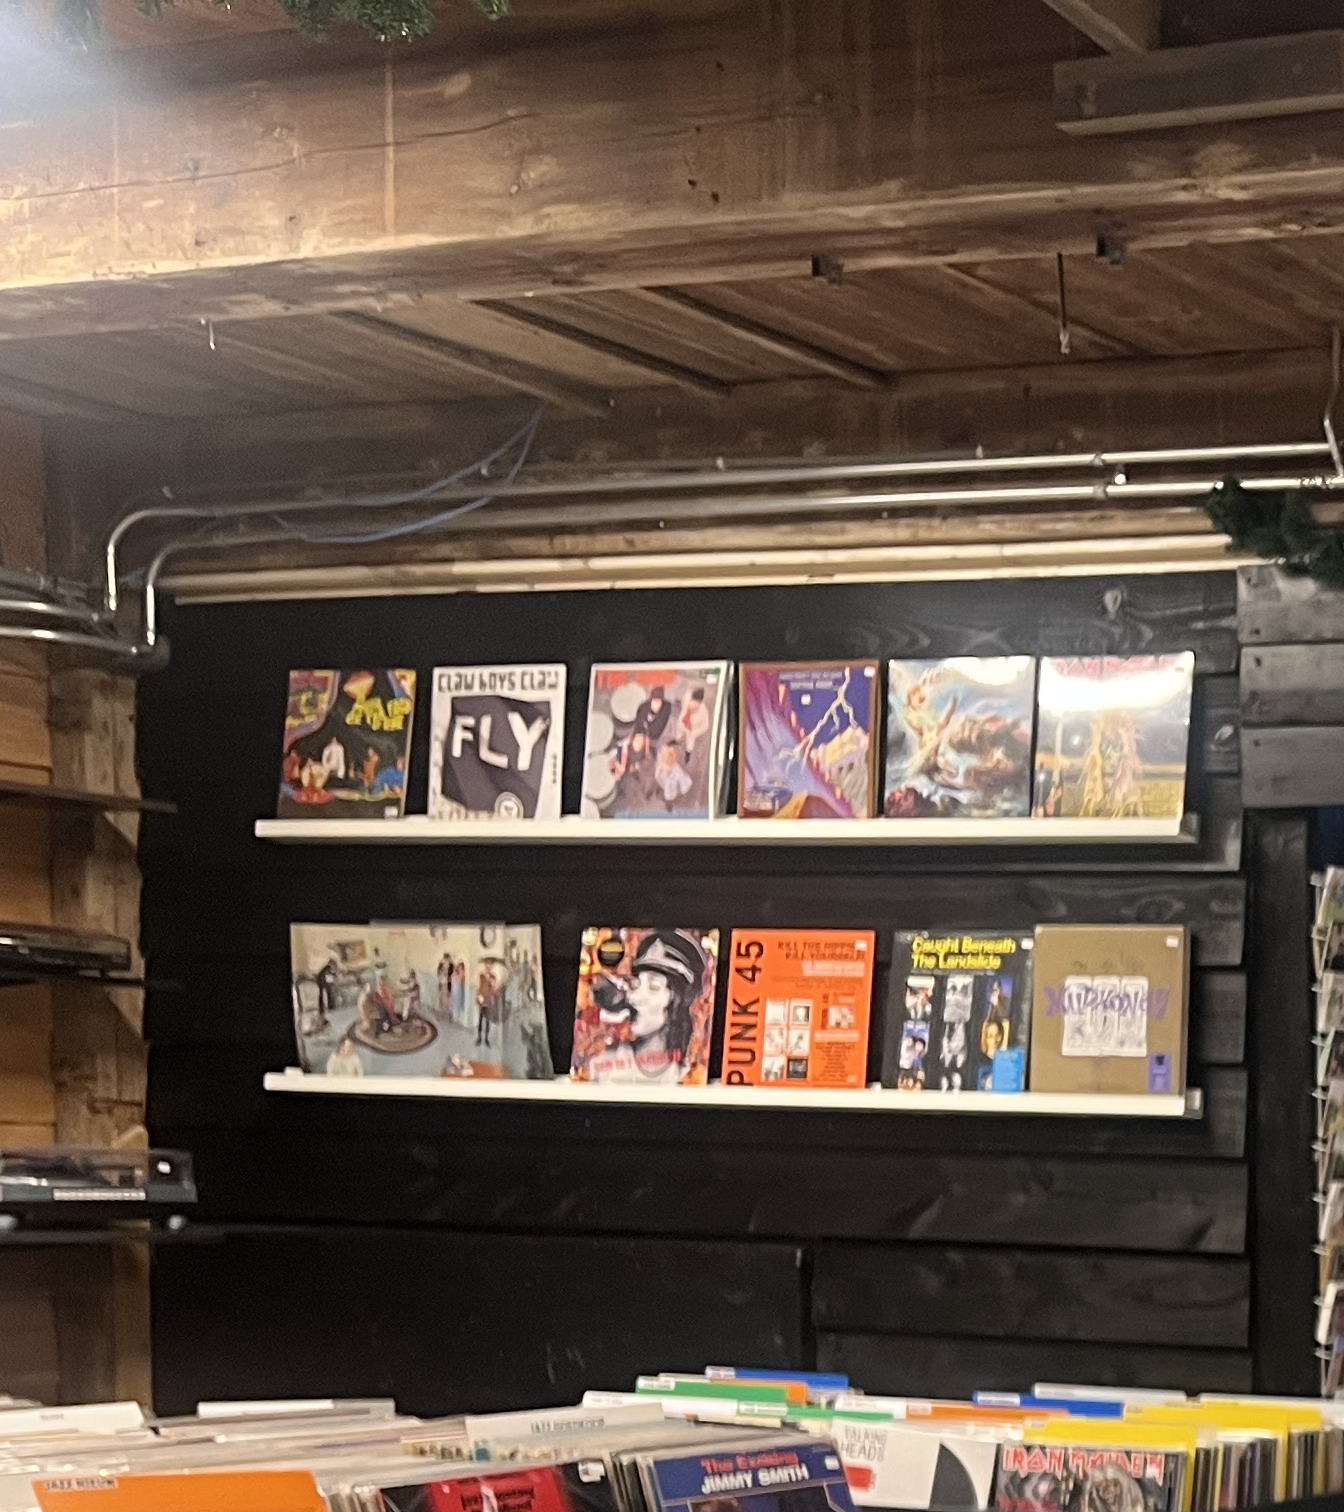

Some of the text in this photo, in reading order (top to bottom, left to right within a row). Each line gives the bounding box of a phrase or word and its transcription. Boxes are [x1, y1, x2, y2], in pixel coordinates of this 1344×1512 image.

[451, 710, 551, 772] FLY
[726, 940, 765, 1086] PUNK 45
[701, 1462, 810, 1495] JIMMY SMITH
[1002, 1444, 1165, 1487] IRON MAIDEN
